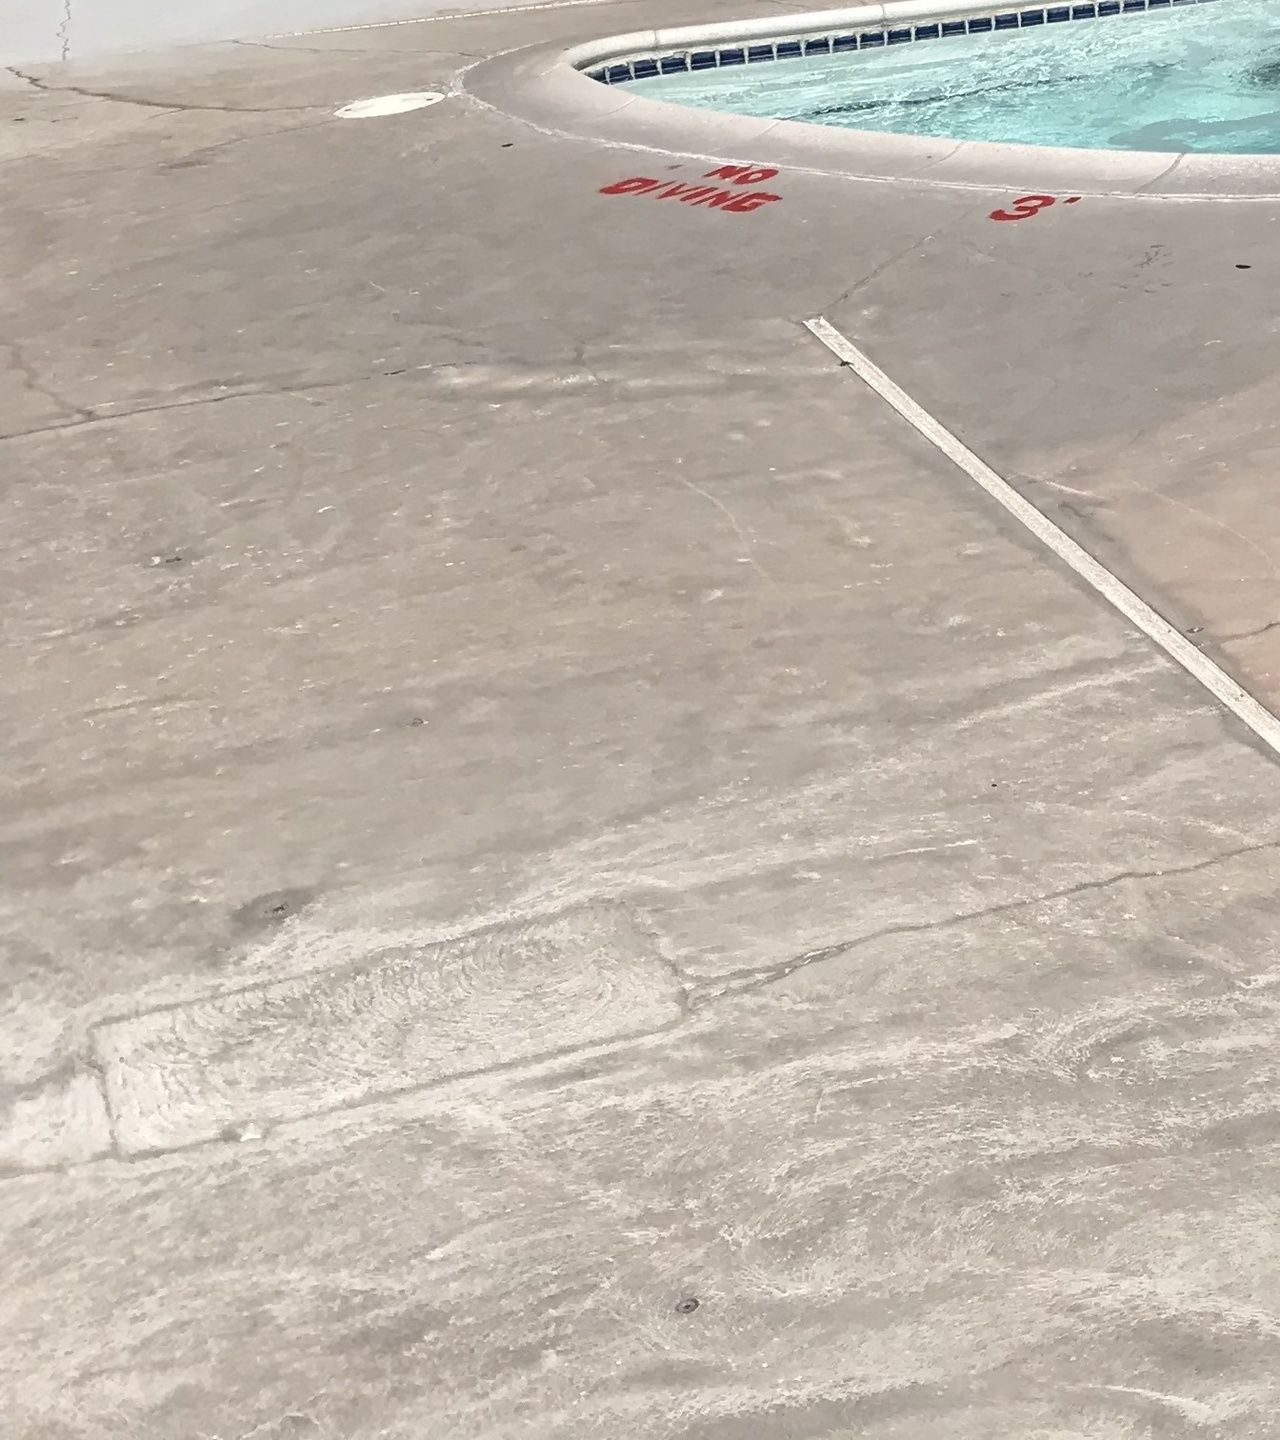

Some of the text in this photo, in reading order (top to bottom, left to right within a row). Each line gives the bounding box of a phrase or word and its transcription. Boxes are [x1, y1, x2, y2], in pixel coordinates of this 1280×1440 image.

[703, 164, 779, 184] NO
[600, 177, 782, 212] DIVING
[989, 195, 1082, 221] 3'
